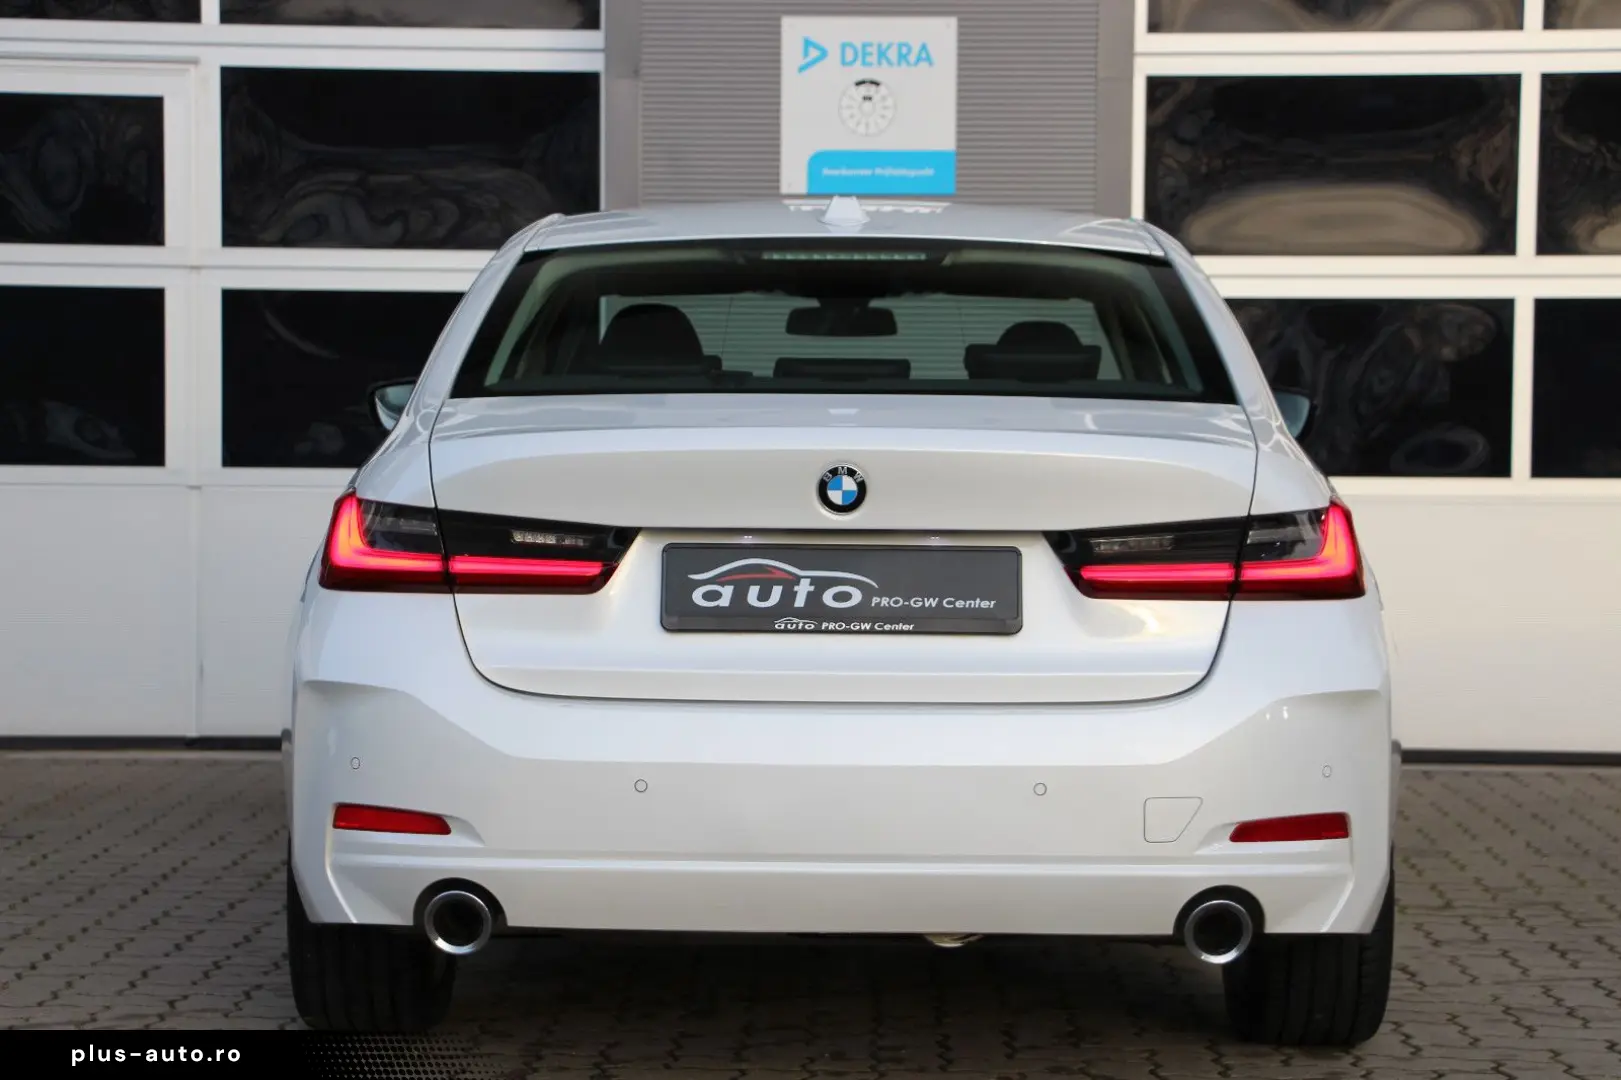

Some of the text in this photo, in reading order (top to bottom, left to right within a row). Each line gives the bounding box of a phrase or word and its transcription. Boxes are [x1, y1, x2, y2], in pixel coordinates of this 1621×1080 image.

[839, 41, 934, 67] DEKRA
[823, 465, 864, 482] BMW
[692, 578, 997, 609] auto PRO-GW Center
[774, 620, 914, 632] auto PRO-GW Center
